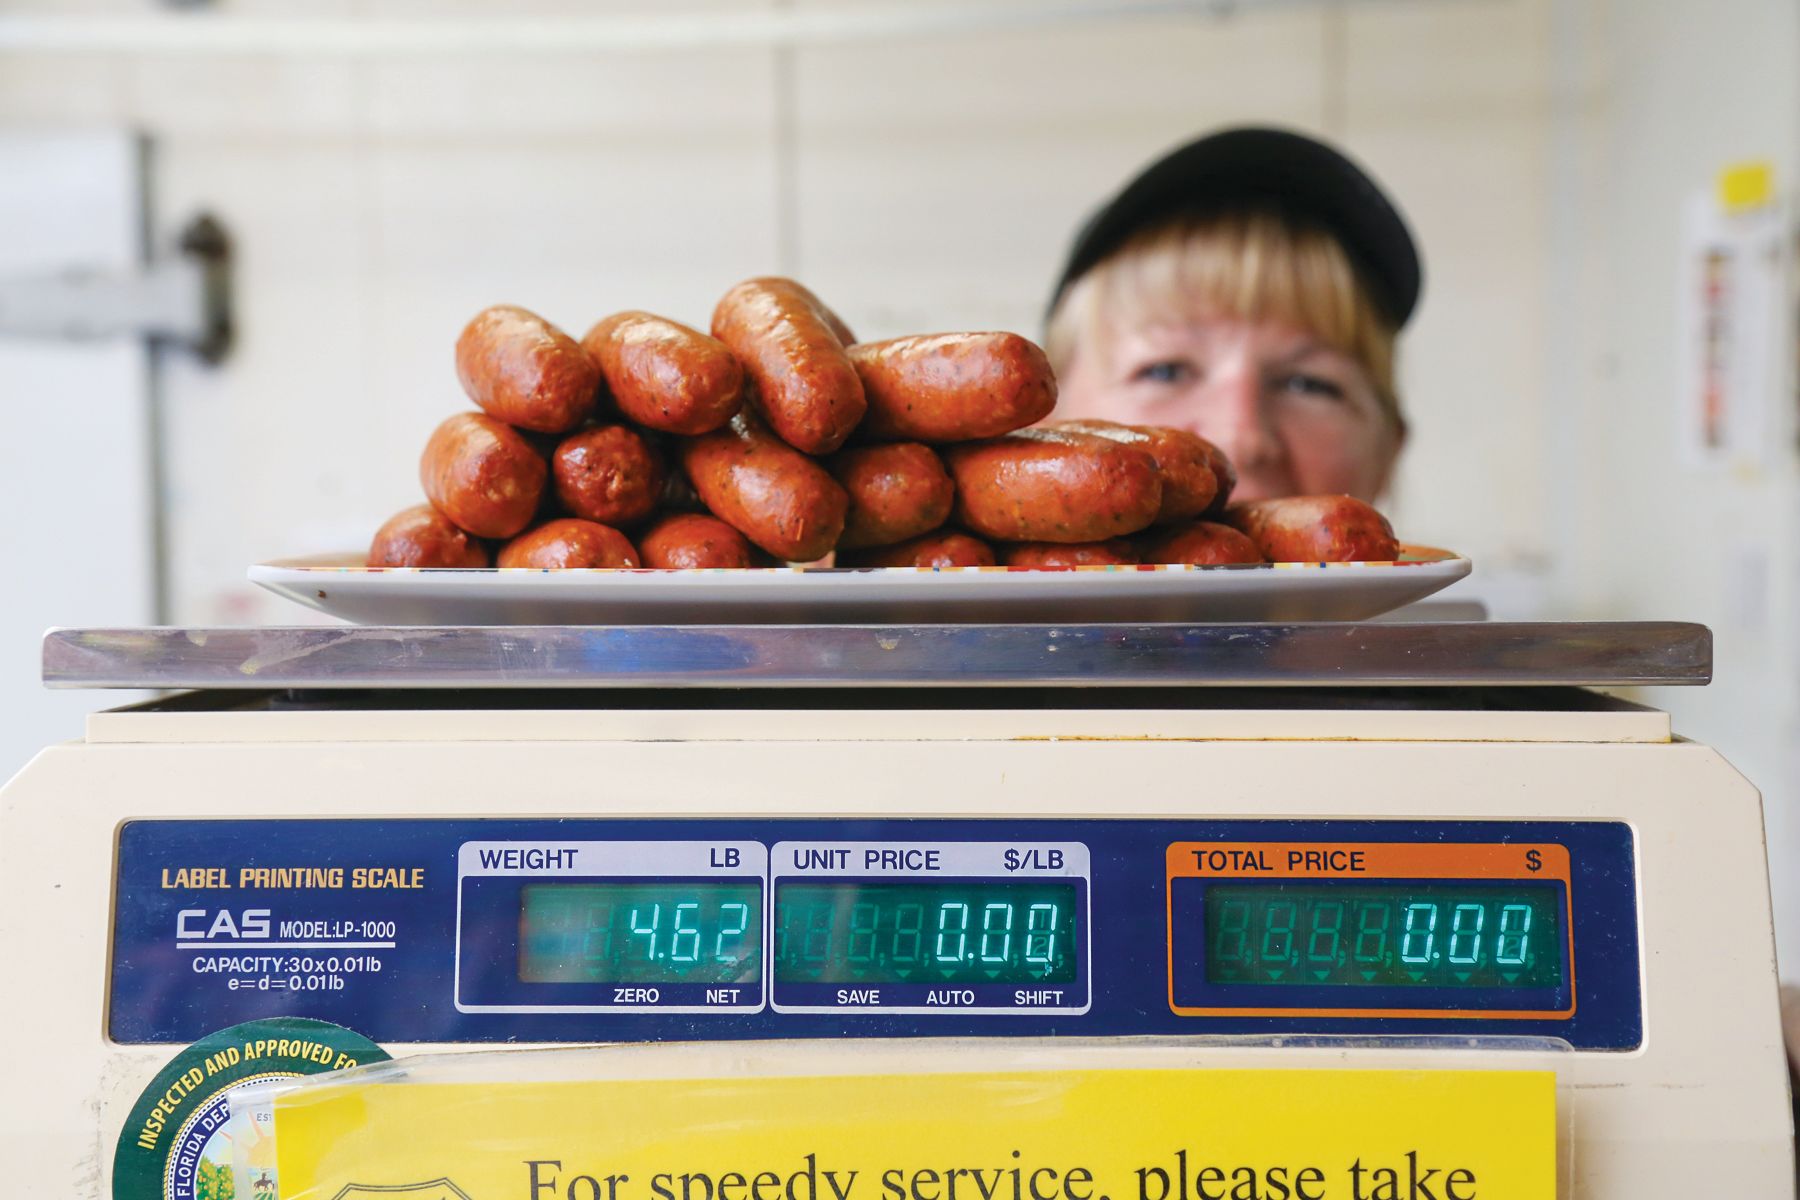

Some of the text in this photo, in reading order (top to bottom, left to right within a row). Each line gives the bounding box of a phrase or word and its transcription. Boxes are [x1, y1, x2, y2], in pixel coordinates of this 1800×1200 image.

[479, 849, 578, 870] WEIGHT
[710, 848, 740, 868] LB
[793, 849, 940, 870] UNIT PRICE
[1004, 848, 1064, 872] $/LB
[1191, 850, 1365, 872] TOTAL PRICE
[1526, 849, 1542, 873] $
[161, 868, 425, 888] LABEL PRINTING SCALE
[176, 908, 396, 939] CAS MODEL:LP-1000
[630, 903, 748, 962] 4.62
[936, 903, 1057, 963] 0.00
[1401, 903, 1532, 965] 0.00
[613, 988, 660, 1003] ZERO
[706, 989, 740, 1004] NET
[837, 990, 880, 1005] SAVE
[926, 990, 975, 1005] AUTO
[1014, 990, 1063, 1005] SHIFT
[137, 1039, 358, 1150] INSPECTED AND APPROVED FO
[177, 1132, 206, 1197] FLORIDA
[522, 1160, 629, 1200] For
[1347, 1150, 1477, 1200] take
